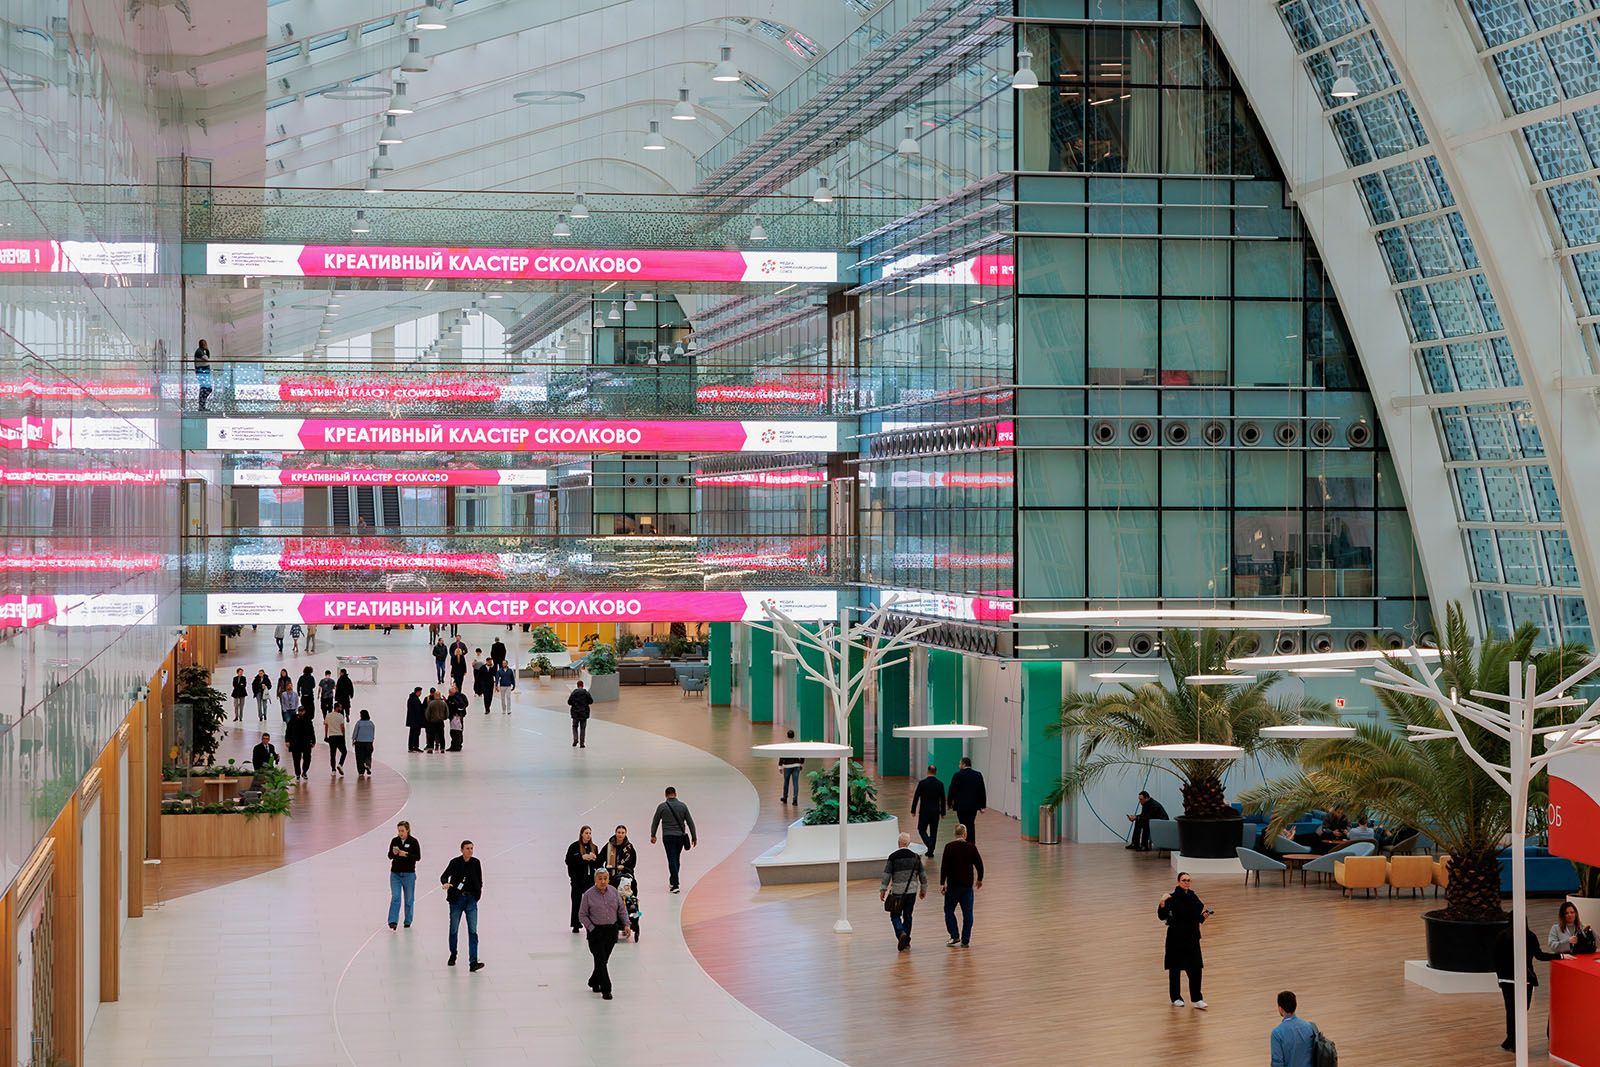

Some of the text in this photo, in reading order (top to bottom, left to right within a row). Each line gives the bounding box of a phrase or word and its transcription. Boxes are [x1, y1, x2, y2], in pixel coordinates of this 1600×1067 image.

[324, 251, 642, 273] КРЕАТИВНЫЙ КЛАСТЕР СКОЛКОВО
[324, 423, 642, 443] КРЕАТИВНЫЙ КЛАСТЕР СКОЛКОВО
[290, 471, 449, 482] КРЕАТИВНЫЙ КЛАСТЕР СКОЛКОВО
[324, 596, 642, 616] КРЕАТИВНЫЙ КЛАСТЕР СКОЛКОВО
